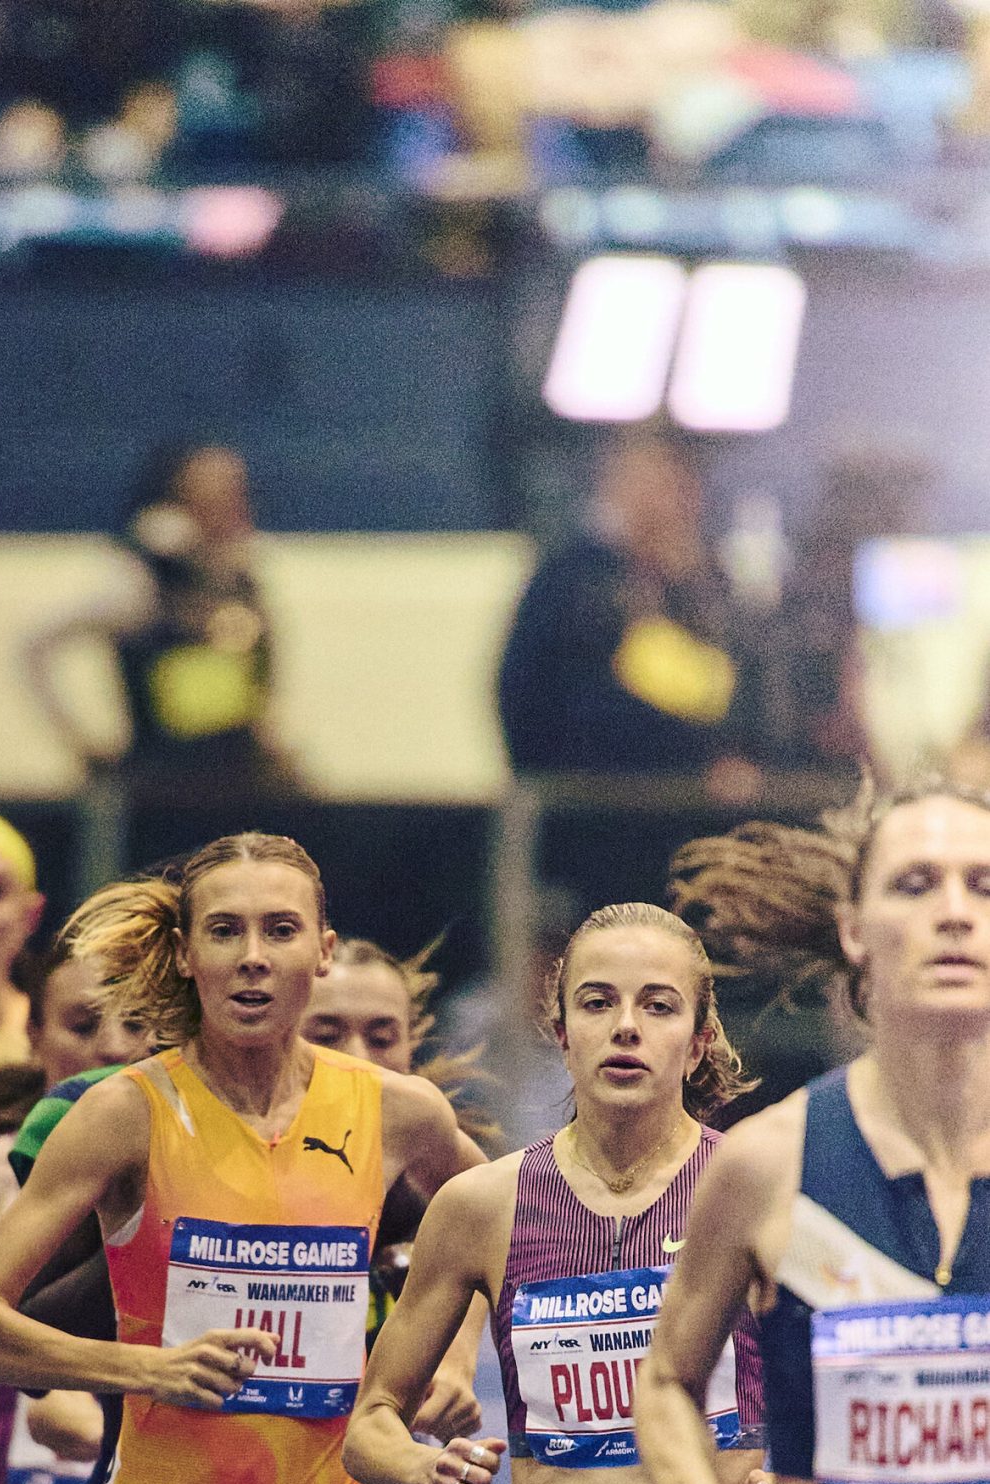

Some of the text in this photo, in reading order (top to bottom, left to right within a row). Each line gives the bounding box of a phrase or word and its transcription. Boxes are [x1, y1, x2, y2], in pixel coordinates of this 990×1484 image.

[189, 1235, 358, 1267] MILLROSE GAMES
[247, 1282, 330, 1302] WANAMAKER
[332, 1284, 355, 1302] MILE
[530, 1282, 666, 1320] MILLROSE GA
[589, 1328, 655, 1352] WANAMA
[549, 1438, 574, 1449] RUN
[849, 1399, 990, 1469] RICHAR
[605, 1448, 637, 1456] ARMORY
